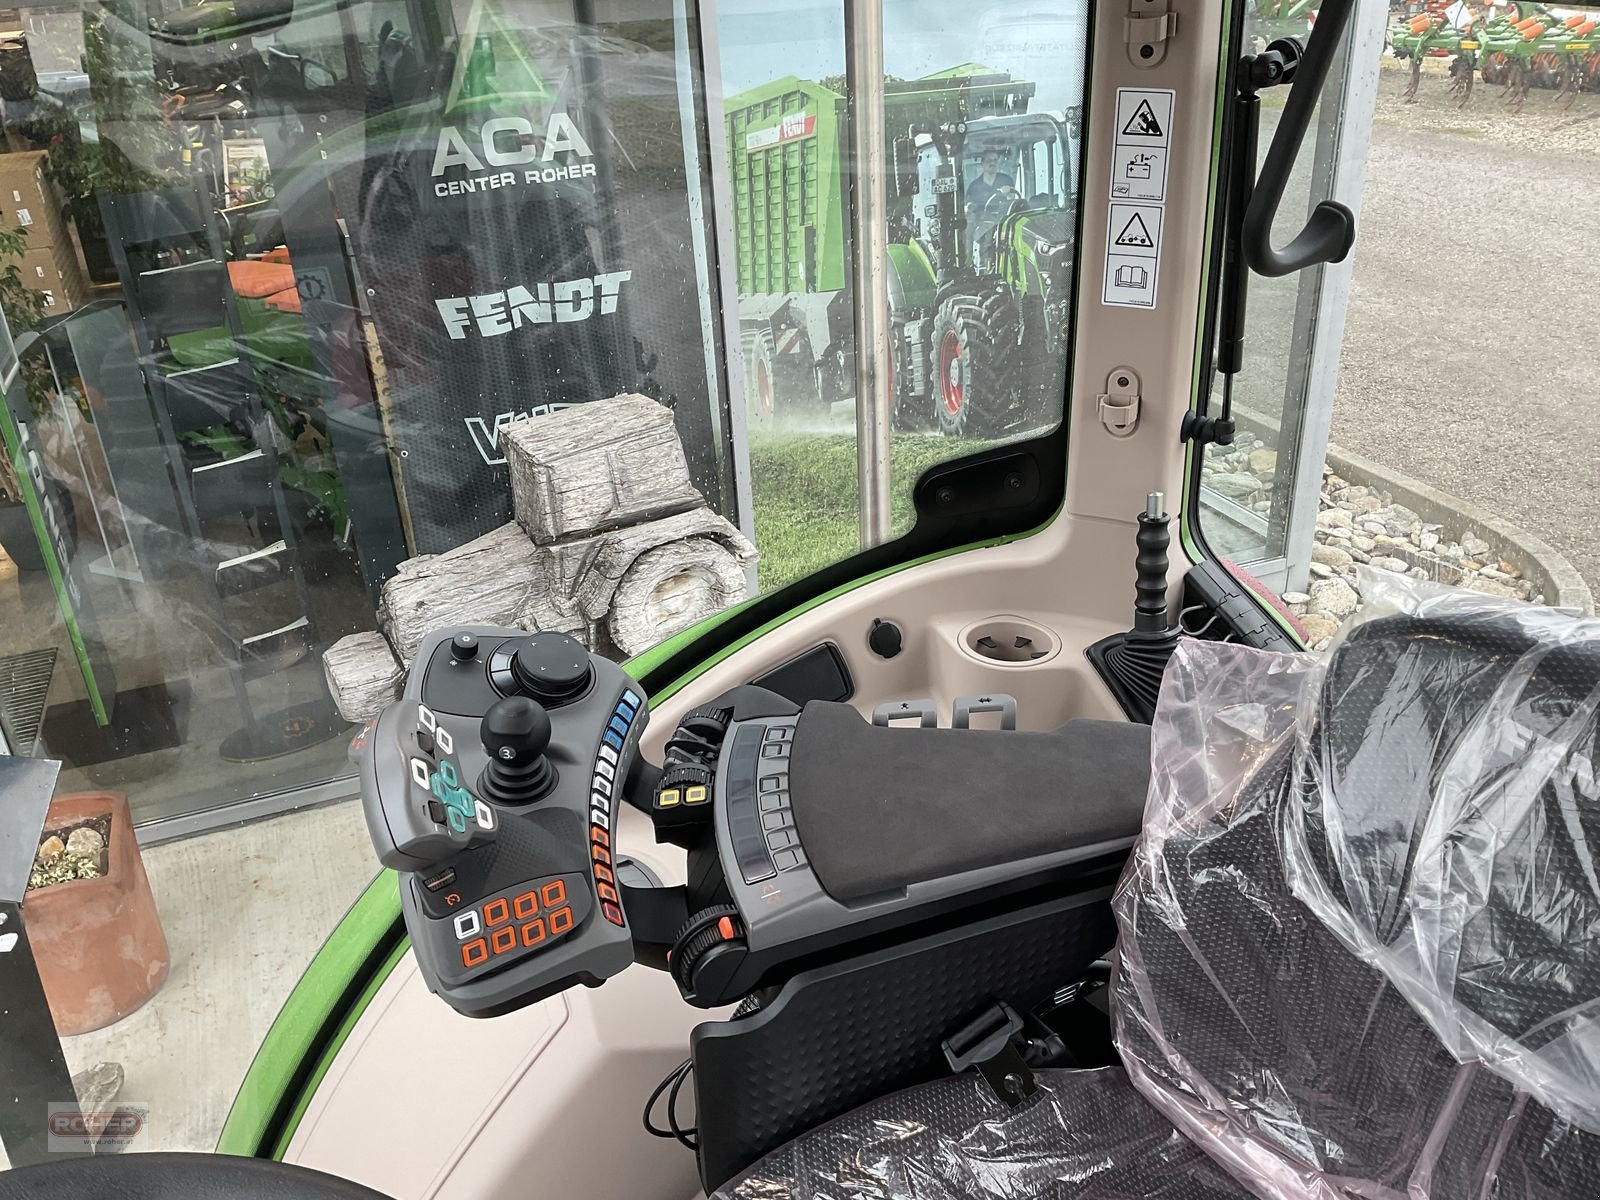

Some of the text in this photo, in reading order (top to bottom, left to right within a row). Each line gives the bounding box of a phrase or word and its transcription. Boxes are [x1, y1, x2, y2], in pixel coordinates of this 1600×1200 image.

[431, 112, 594, 177] ACA
[434, 163, 597, 198] CENTER ROHER
[435, 270, 632, 340] FENDT
